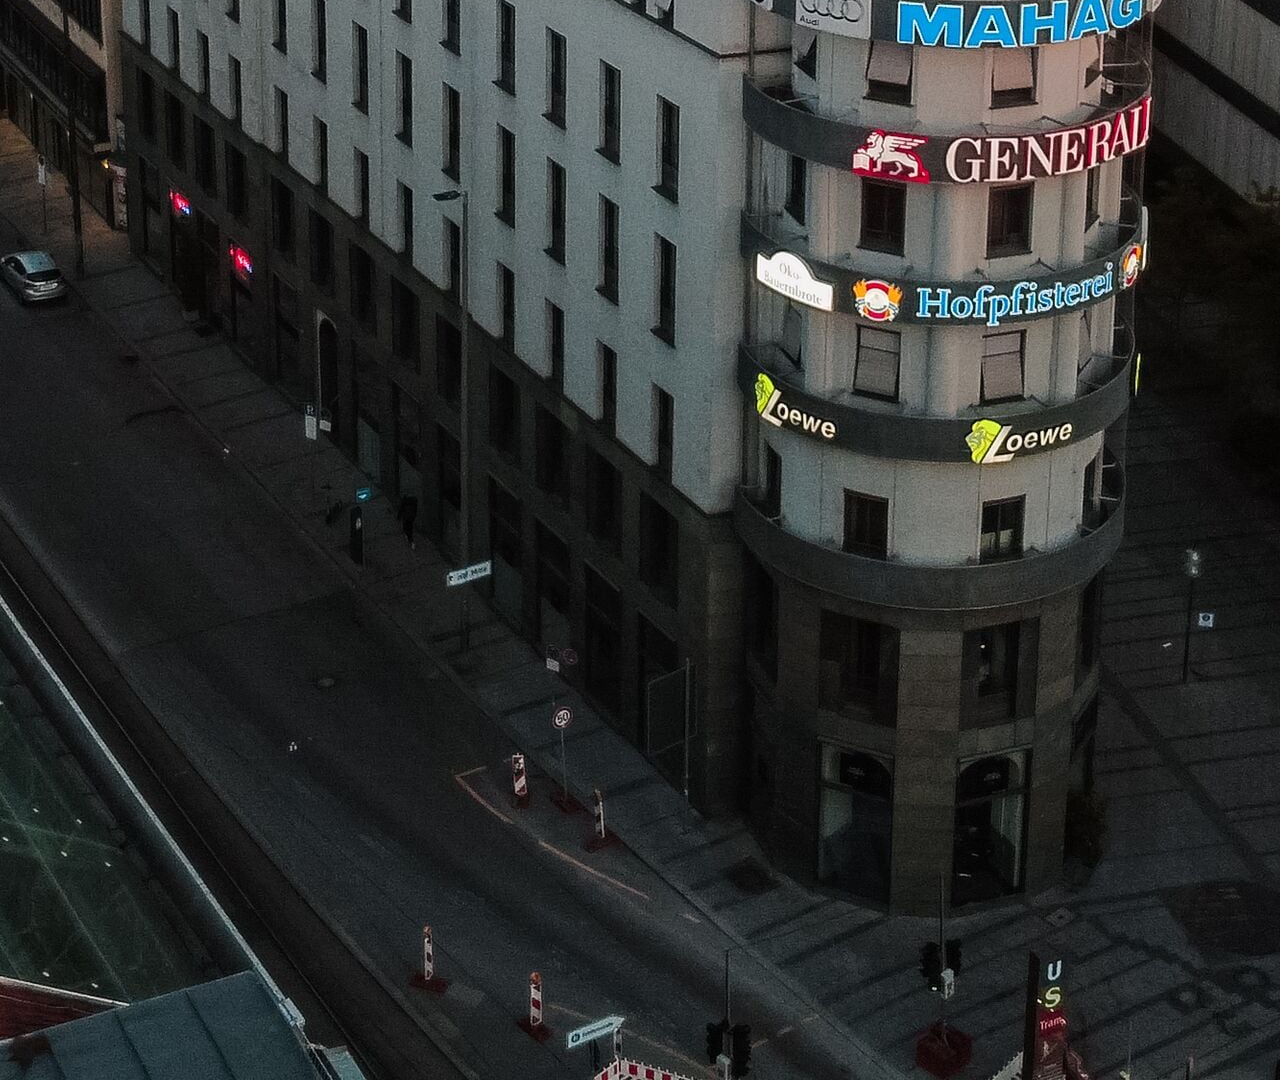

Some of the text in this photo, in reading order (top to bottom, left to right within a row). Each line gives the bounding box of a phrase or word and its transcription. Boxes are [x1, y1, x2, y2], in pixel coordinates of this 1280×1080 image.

[916, 261, 1114, 327] Hofpfisterei
[761, 389, 836, 439] Loewe
[981, 423, 1073, 464] Loewe
[1047, 960, 1062, 981] U
[1045, 986, 1061, 1008] S
